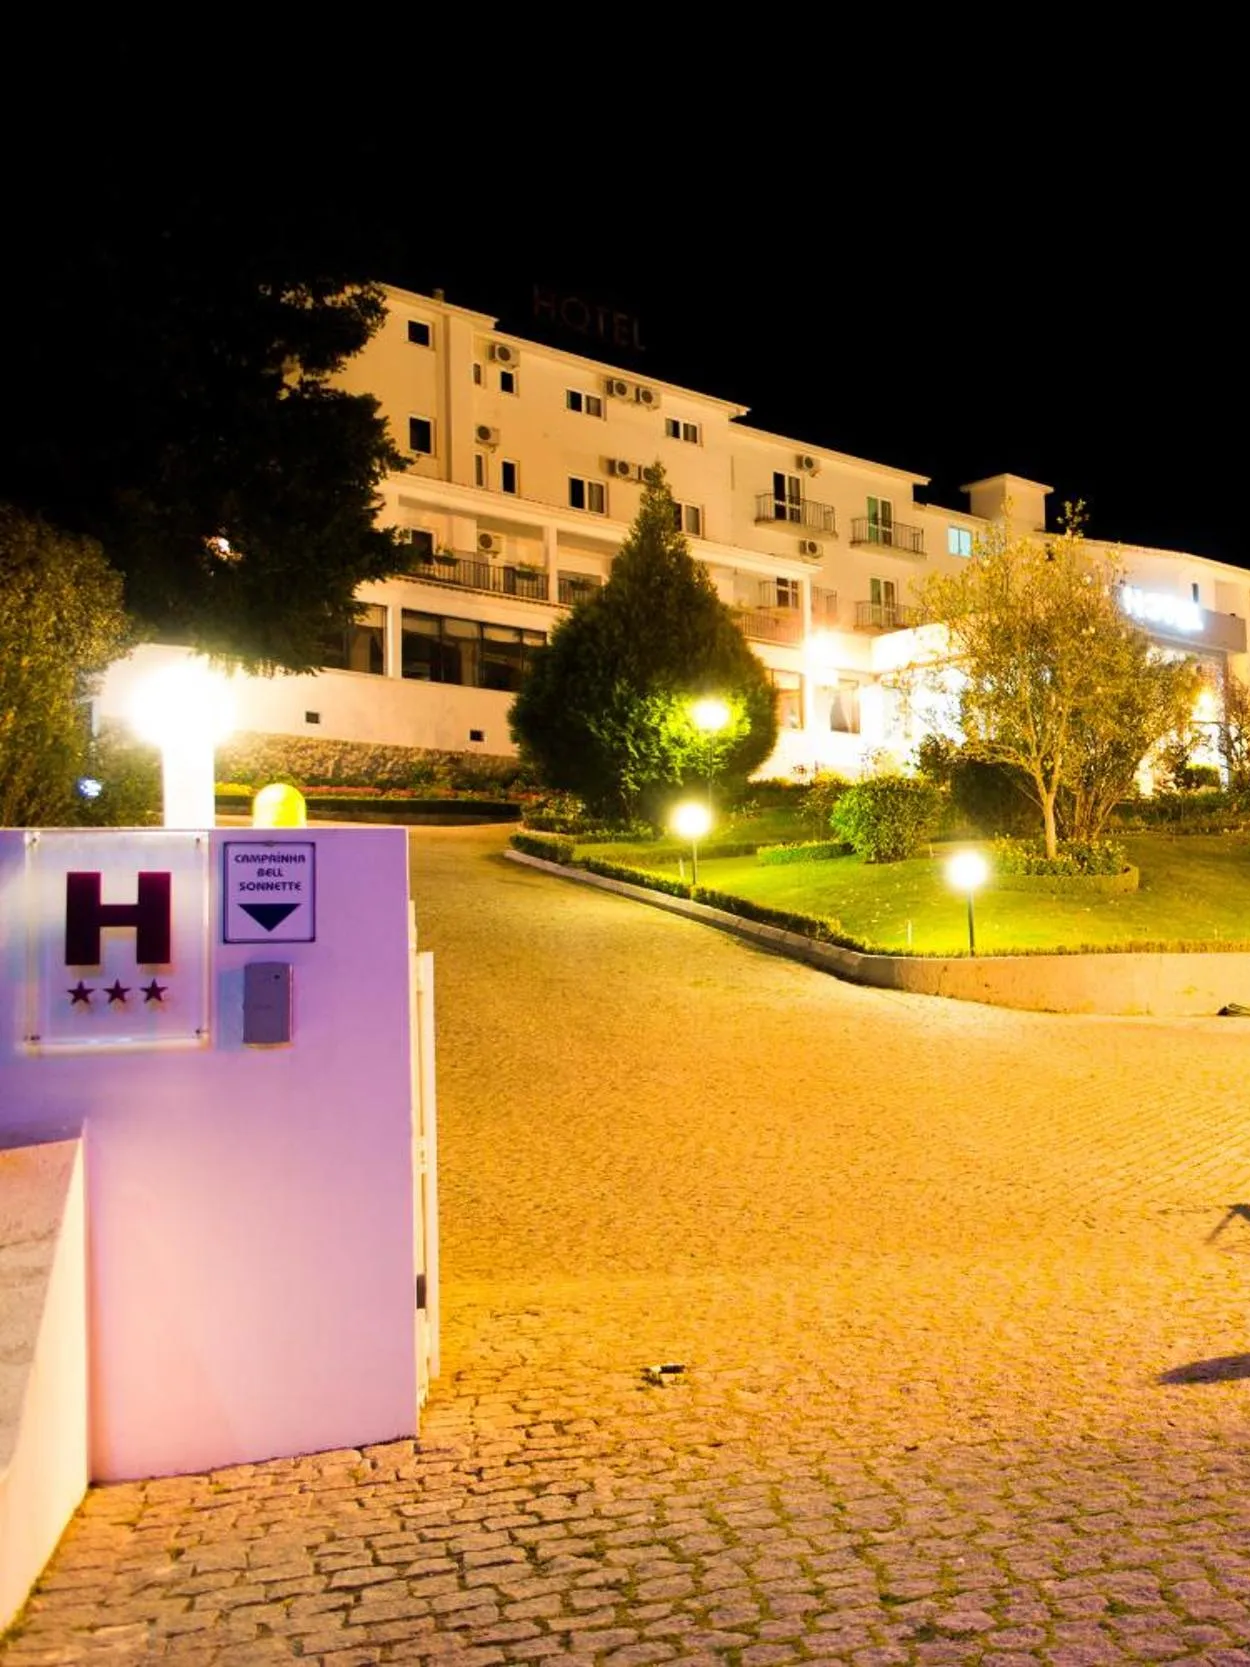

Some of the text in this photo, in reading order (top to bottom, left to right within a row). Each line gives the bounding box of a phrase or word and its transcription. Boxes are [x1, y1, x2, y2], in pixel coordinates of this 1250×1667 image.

[533, 284, 646, 351] HOTEL
[239, 881, 301, 892] SONNETTE
[257, 868, 284, 878] BELL
[65, 872, 171, 965] H
